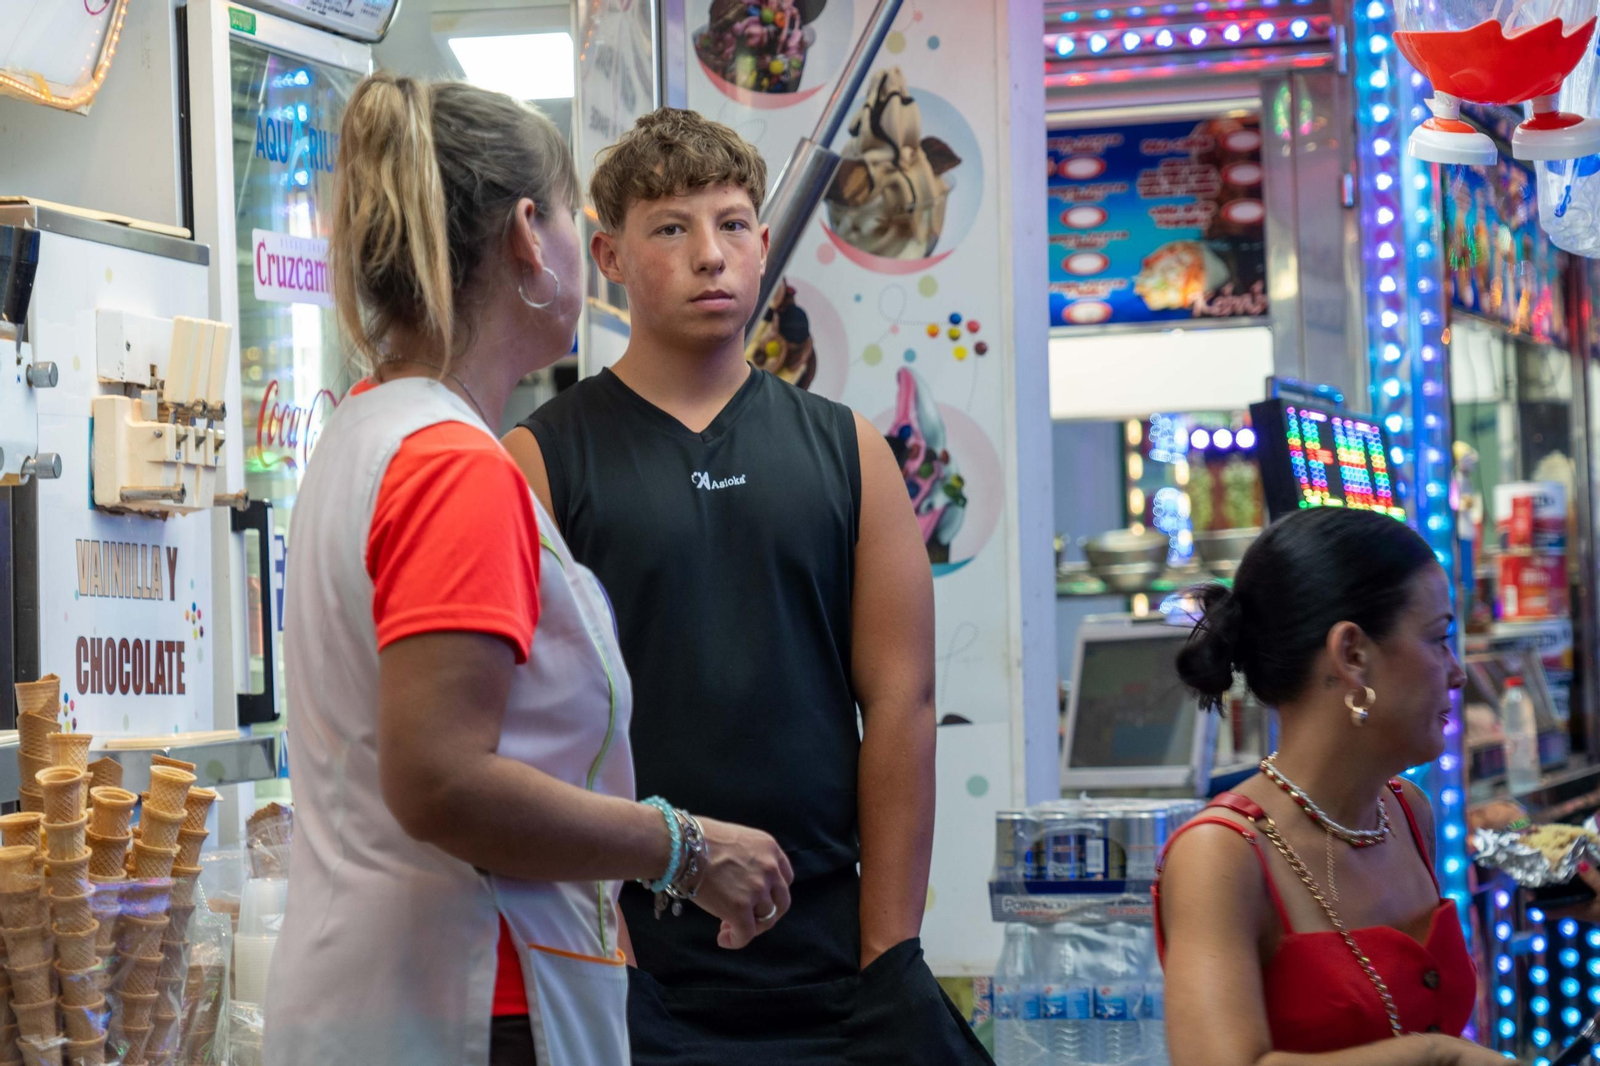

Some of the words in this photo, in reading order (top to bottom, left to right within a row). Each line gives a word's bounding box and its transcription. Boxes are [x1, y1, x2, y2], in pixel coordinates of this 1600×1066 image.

[256, 238, 331, 293] Cruzcam
[75, 538, 163, 601] VAINILLA
[166, 546, 178, 602] Y
[75, 636, 186, 696] CHOCOLATE
